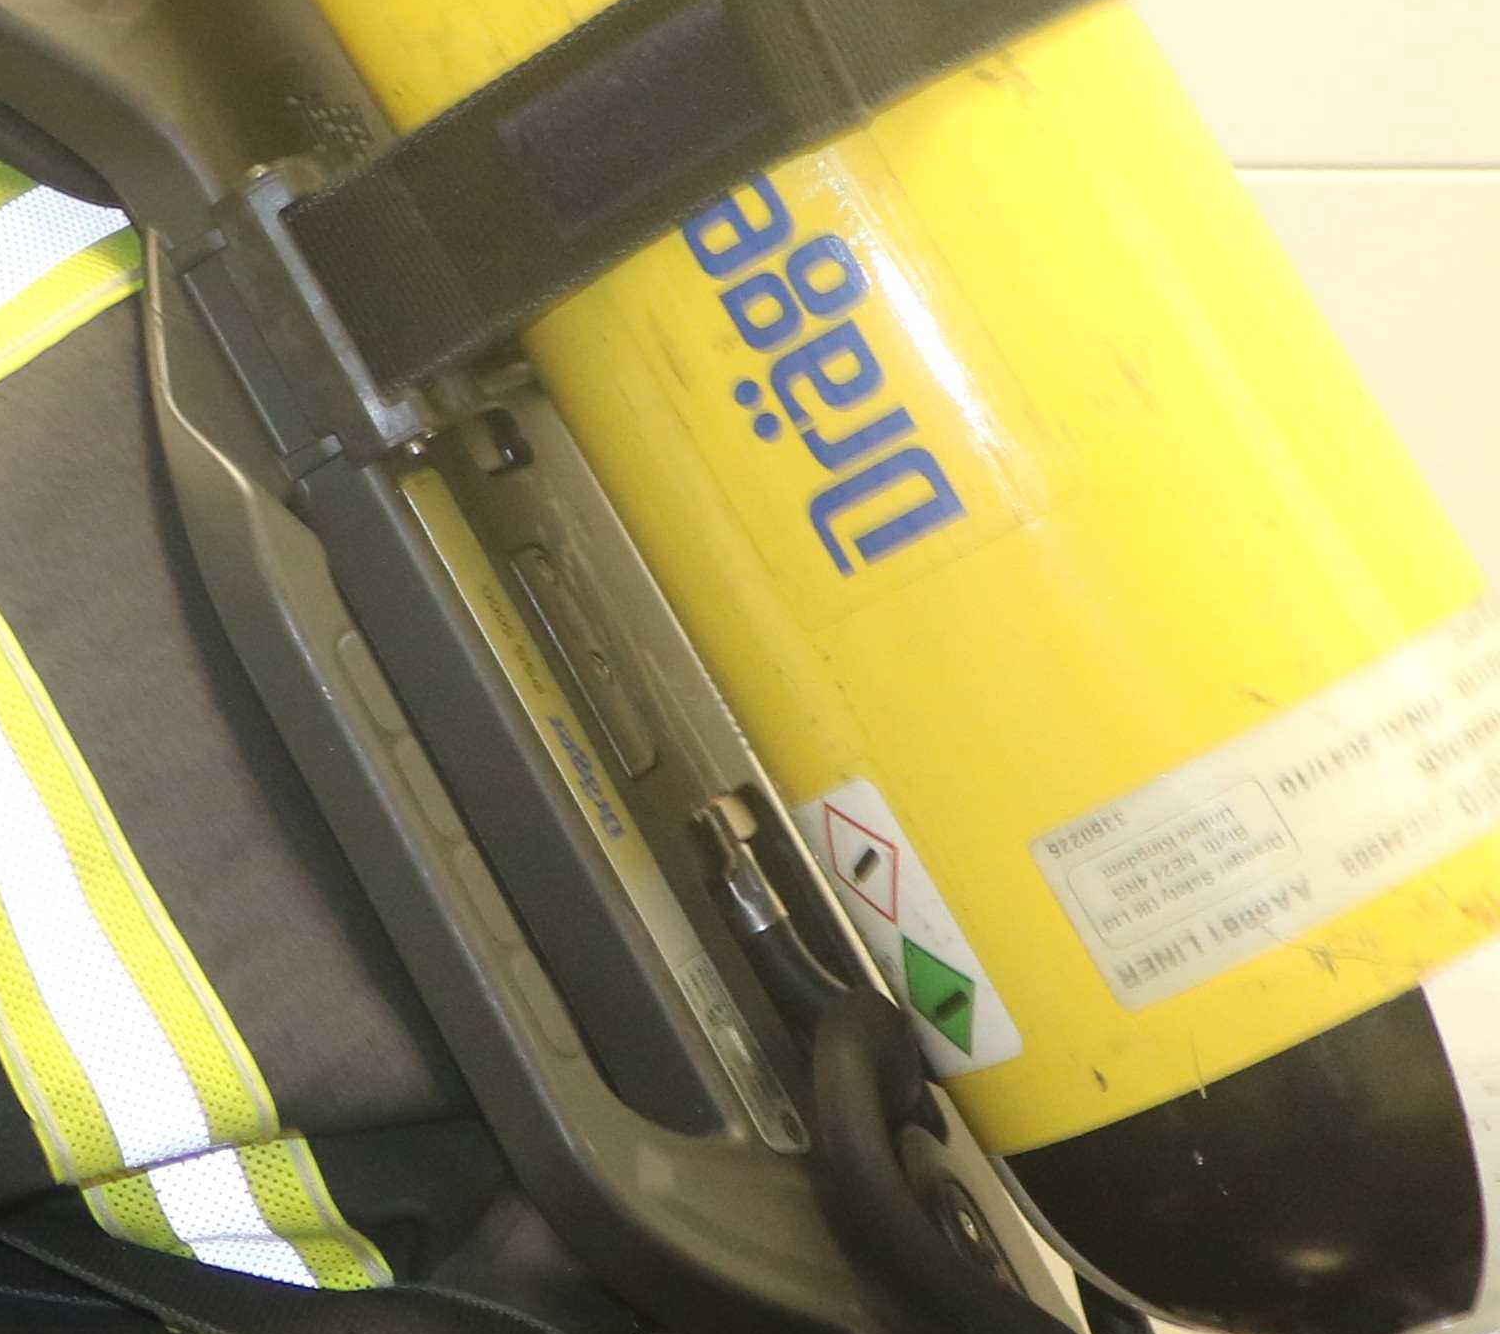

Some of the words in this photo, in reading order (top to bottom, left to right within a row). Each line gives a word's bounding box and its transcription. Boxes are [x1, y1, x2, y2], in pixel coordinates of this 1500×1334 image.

[685, 170, 963, 579] Dräge
[1177, 804, 1234, 843] United
[1101, 833, 1177, 880] Kingdom
[1159, 866, 1214, 905] Safety
[1101, 909, 1131, 933] Ltd
[1117, 935, 1202, 990] LINER
